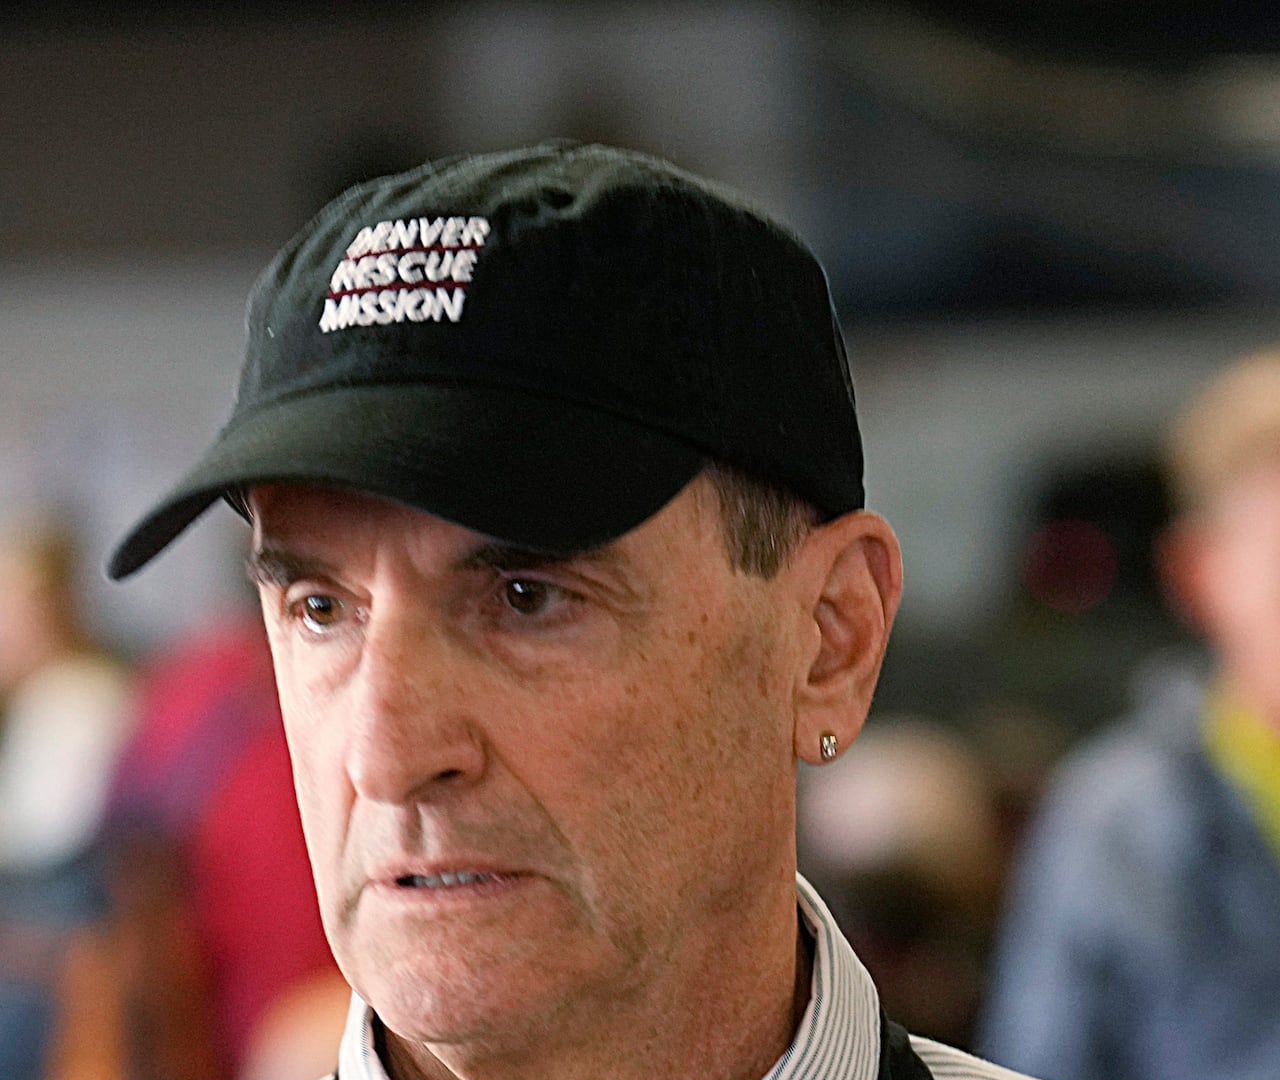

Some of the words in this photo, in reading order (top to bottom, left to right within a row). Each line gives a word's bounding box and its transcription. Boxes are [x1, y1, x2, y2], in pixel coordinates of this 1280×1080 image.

[346, 216, 491, 261] DENVER
[330, 250, 478, 293] RESCUE
[319, 287, 466, 333] MISSION
